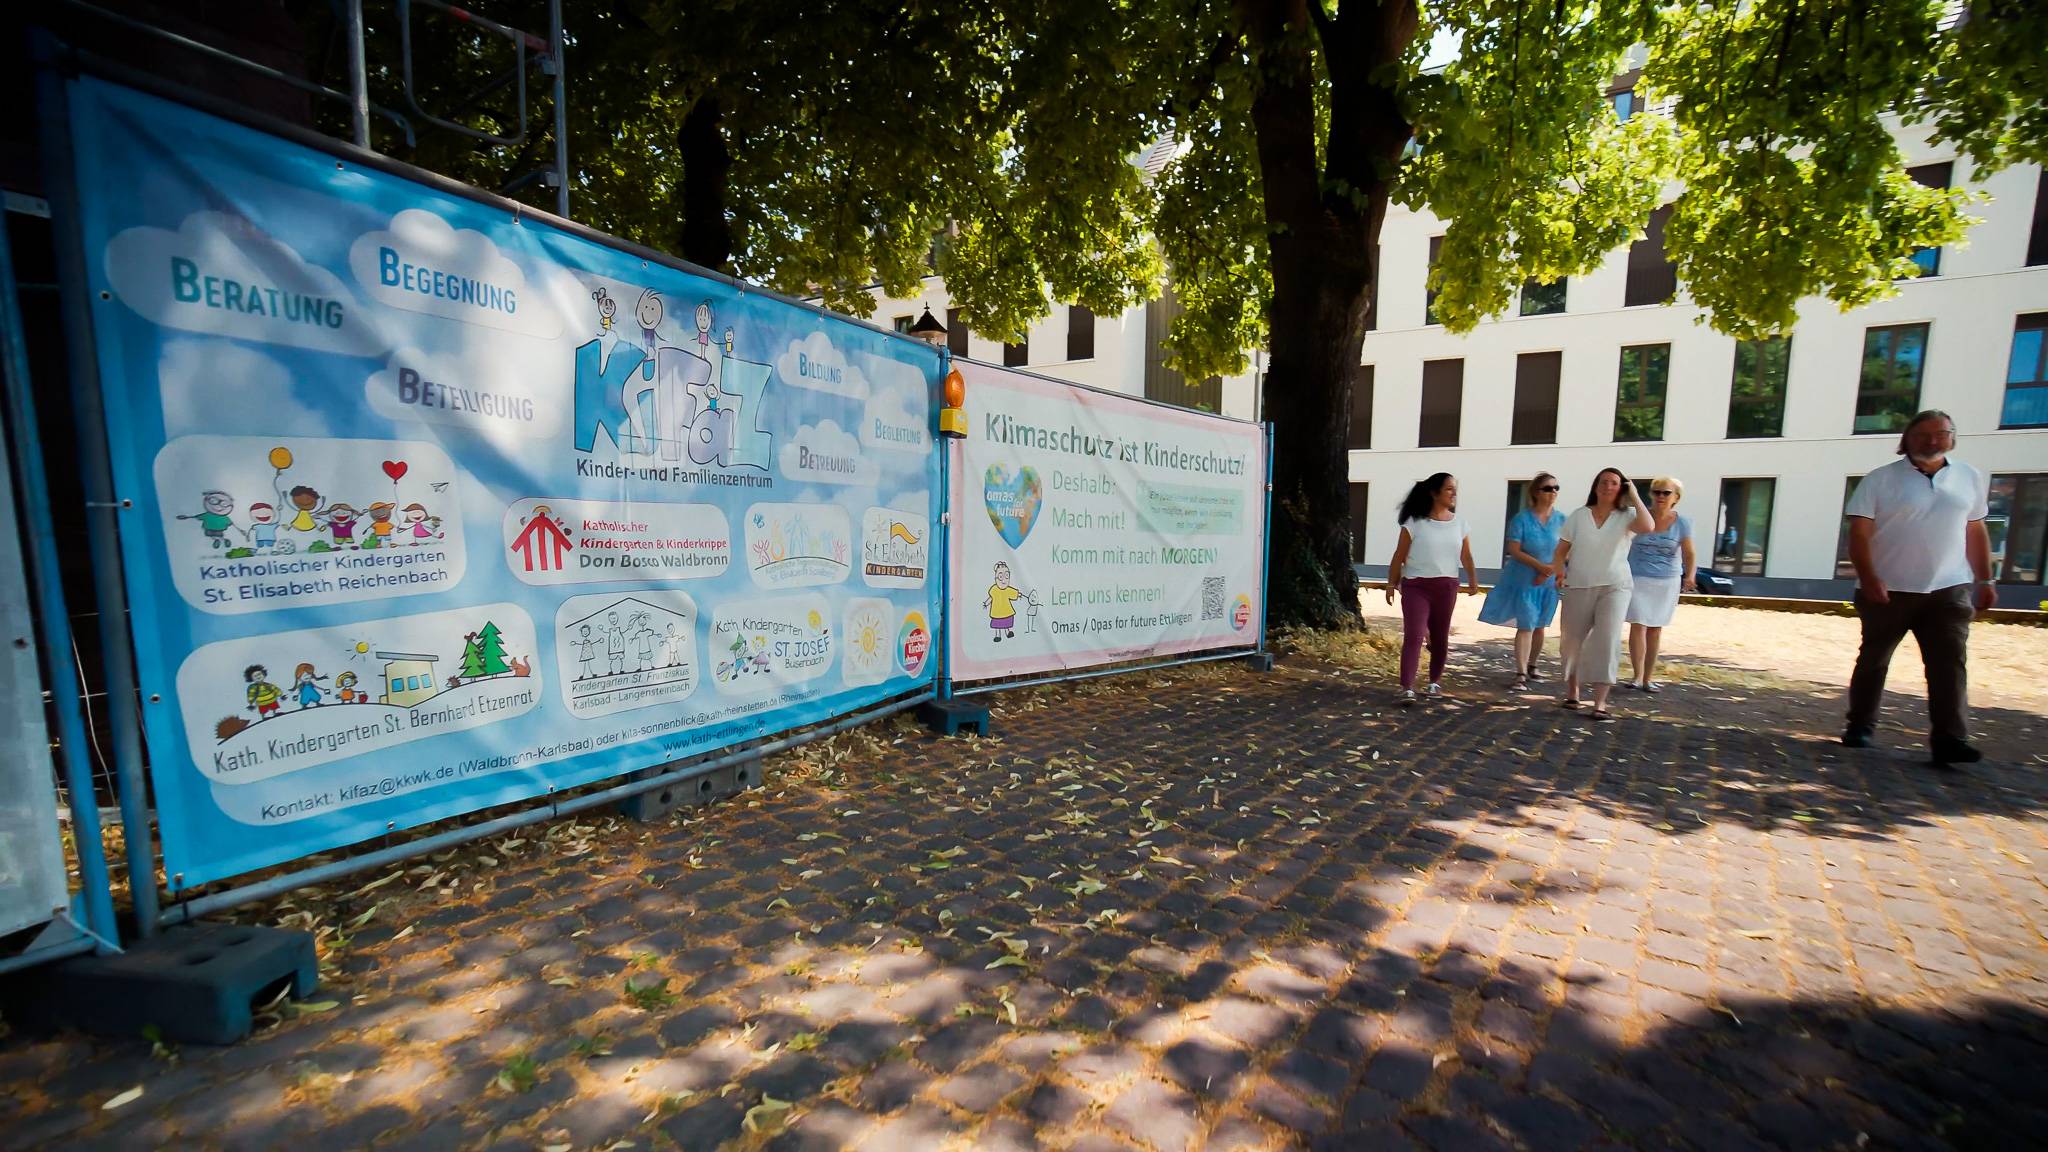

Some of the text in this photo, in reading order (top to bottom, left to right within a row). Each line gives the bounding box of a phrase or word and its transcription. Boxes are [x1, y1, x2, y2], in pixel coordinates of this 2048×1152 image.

[171, 256, 344, 329] BERATUNG
[379, 246, 517, 314] BEGEGNUNG
[799, 352, 842, 384] BILDUNG
[399, 367, 535, 422] BETEILIGUNG
[875, 418, 921, 445] BEGLEITUNG
[985, 412, 1246, 476] Klimaschutz ist Kinderschutz!
[576, 458, 773, 489] Kinder- und Familienzentrum
[799, 445, 856, 474] BETREUUNG
[1052, 470, 1116, 496] Deshalb:
[583, 519, 649, 533] Katholischer
[1052, 506, 1093, 530] Mach
[1097, 510, 1126, 531] mit!
[580, 538, 728, 552] Kindergarten & Kinderkrippe
[1051, 544, 1098, 565] Komm
[1102, 545, 1126, 564] mit
[1128, 547, 1158, 565] nach
[200, 549, 446, 581] Katholischer Kindergarten
[579, 553, 729, 569] Don Bosco Waldbronn
[203, 567, 449, 604] St. Elisabeth Reichenbach
[1051, 584, 1166, 607] Lern uns kennen!
[1051, 620, 1080, 634] Omas
[1090, 617, 1113, 634] Opas
[1115, 615, 1128, 629] for
[1130, 613, 1157, 629] future
[1159, 611, 1193, 627] Ettlingen
[794, 635, 831, 659] JOSEF
[571, 676, 629, 694] Kindergarten
[572, 695, 611, 711] Karlsbad
[618, 683, 691, 702] Langensteinbach
[213, 689, 534, 774] Kath. Kindergarten St. Bernhard Etzenrot
[663, 718, 766, 752] www.kath-ettlingen.de
[261, 793, 334, 821] Kontakt:
[339, 765, 454, 802] kifaz@kkwk.de
[458, 735, 594, 778] (Waldbronn-Karlsbad)
[596, 732, 620, 748] oder
